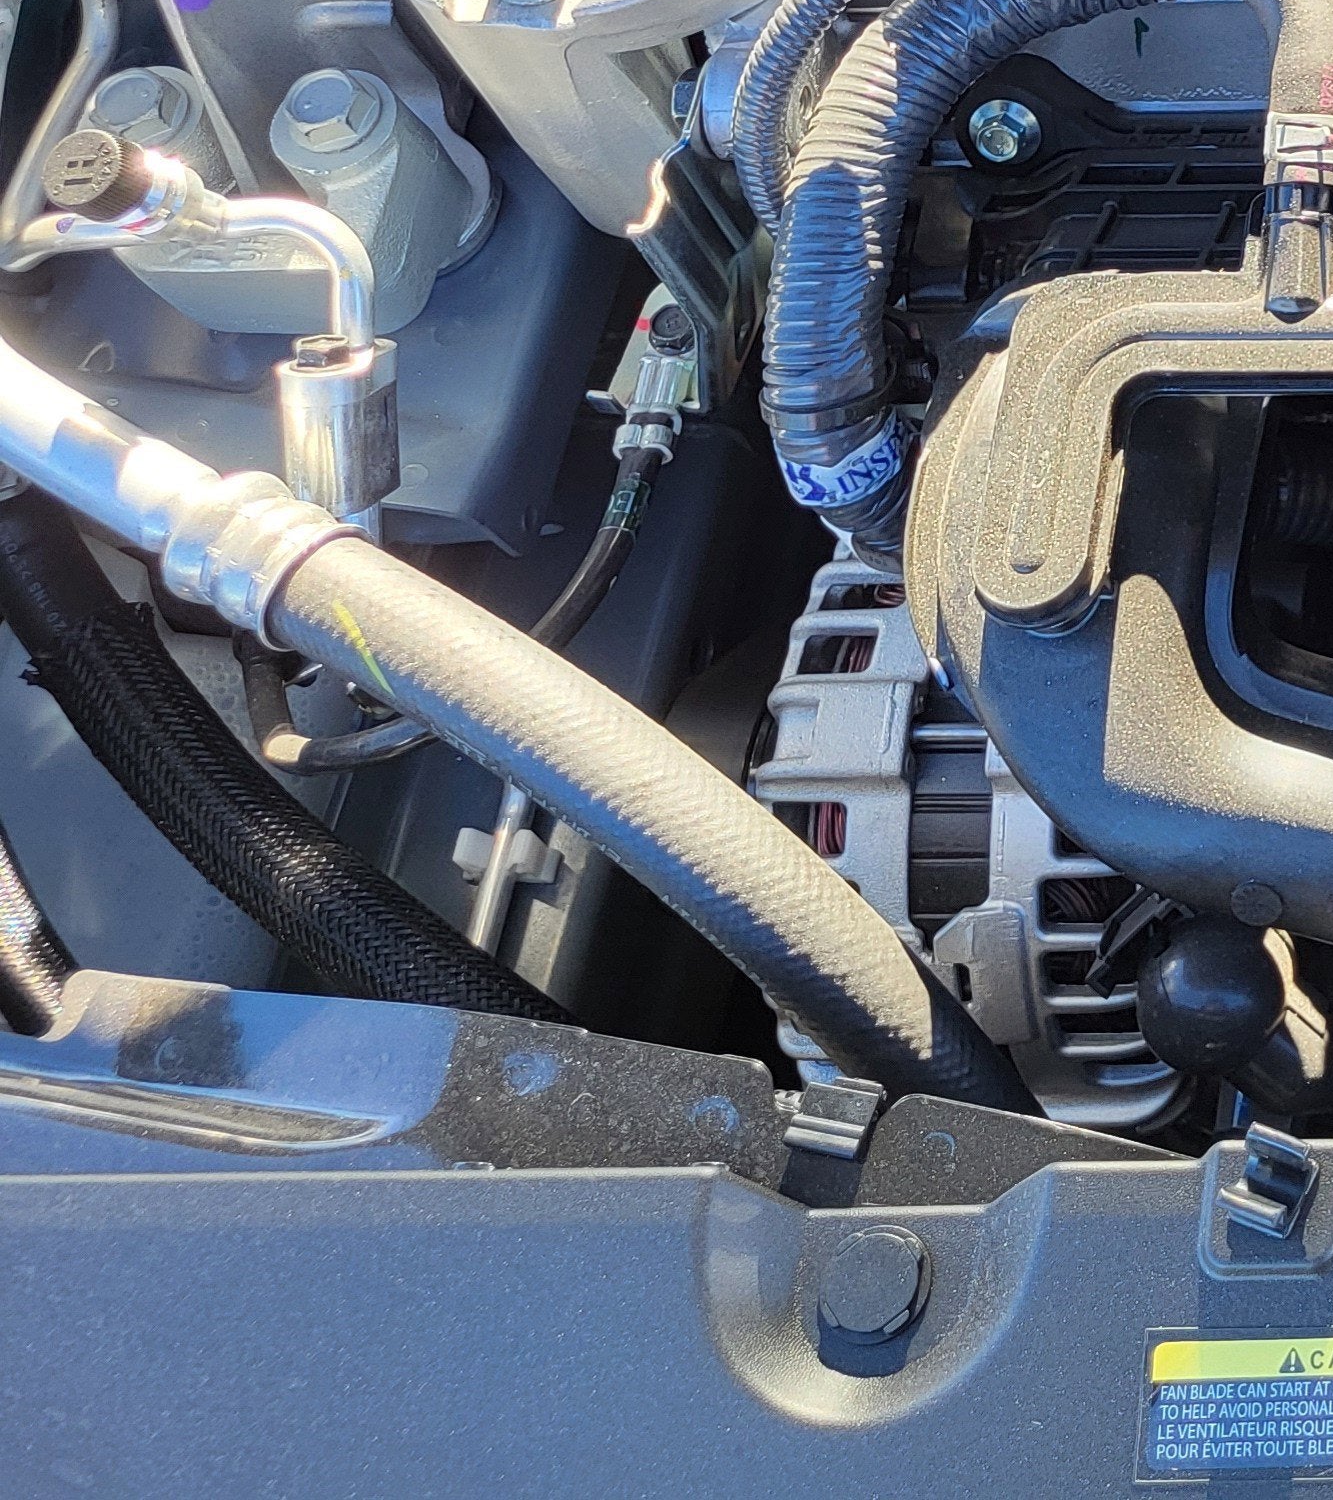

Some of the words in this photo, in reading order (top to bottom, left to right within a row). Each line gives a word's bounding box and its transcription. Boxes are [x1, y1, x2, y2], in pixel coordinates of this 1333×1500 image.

[1160, 1384, 1188, 1401] FAN
[1190, 1383, 1235, 1400] BLADE
[1237, 1382, 1267, 1399] CAN
[1269, 1380, 1312, 1398] START
[1313, 1380, 1330, 1396] AT
[1160, 1404, 1180, 1420] TO
[1182, 1403, 1217, 1419] HELP
[1219, 1402, 1263, 1419] AVOID
[1157, 1424, 1175, 1441] LE
[1177, 1420, 1281, 1440] VENTILATEUR
[1156, 1443, 1200, 1460] POUR
[1202, 1438, 1252, 1458] ÉVITER
[1254, 1439, 1305, 1456] TOUTE
